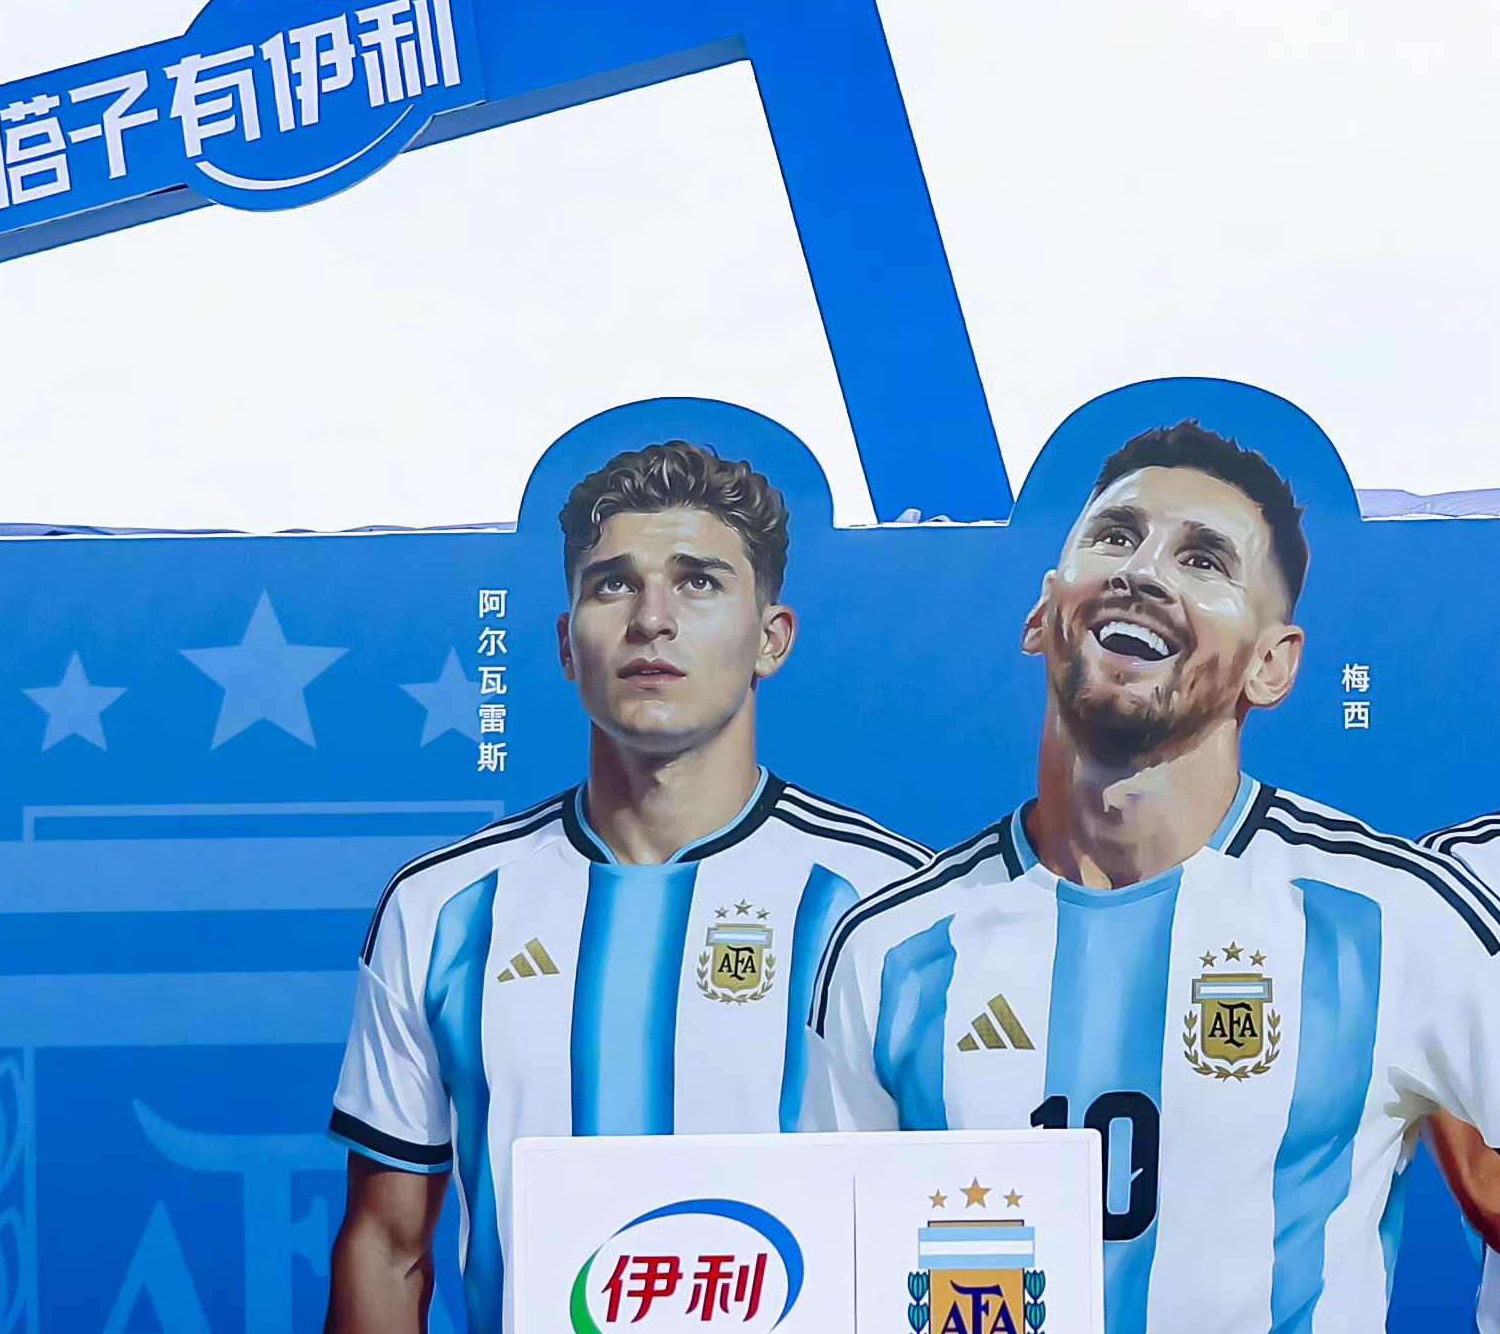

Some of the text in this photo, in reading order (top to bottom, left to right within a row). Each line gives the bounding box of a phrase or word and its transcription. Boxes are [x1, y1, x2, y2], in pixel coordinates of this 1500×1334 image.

[477, 589, 508, 774] 阿尔瓦雷斯
[1341, 662, 1371, 731] 梅西
[717, 946, 757, 979] AFA
[1208, 1002, 1258, 1048] AFA
[603, 1253, 767, 1323] 伊利
